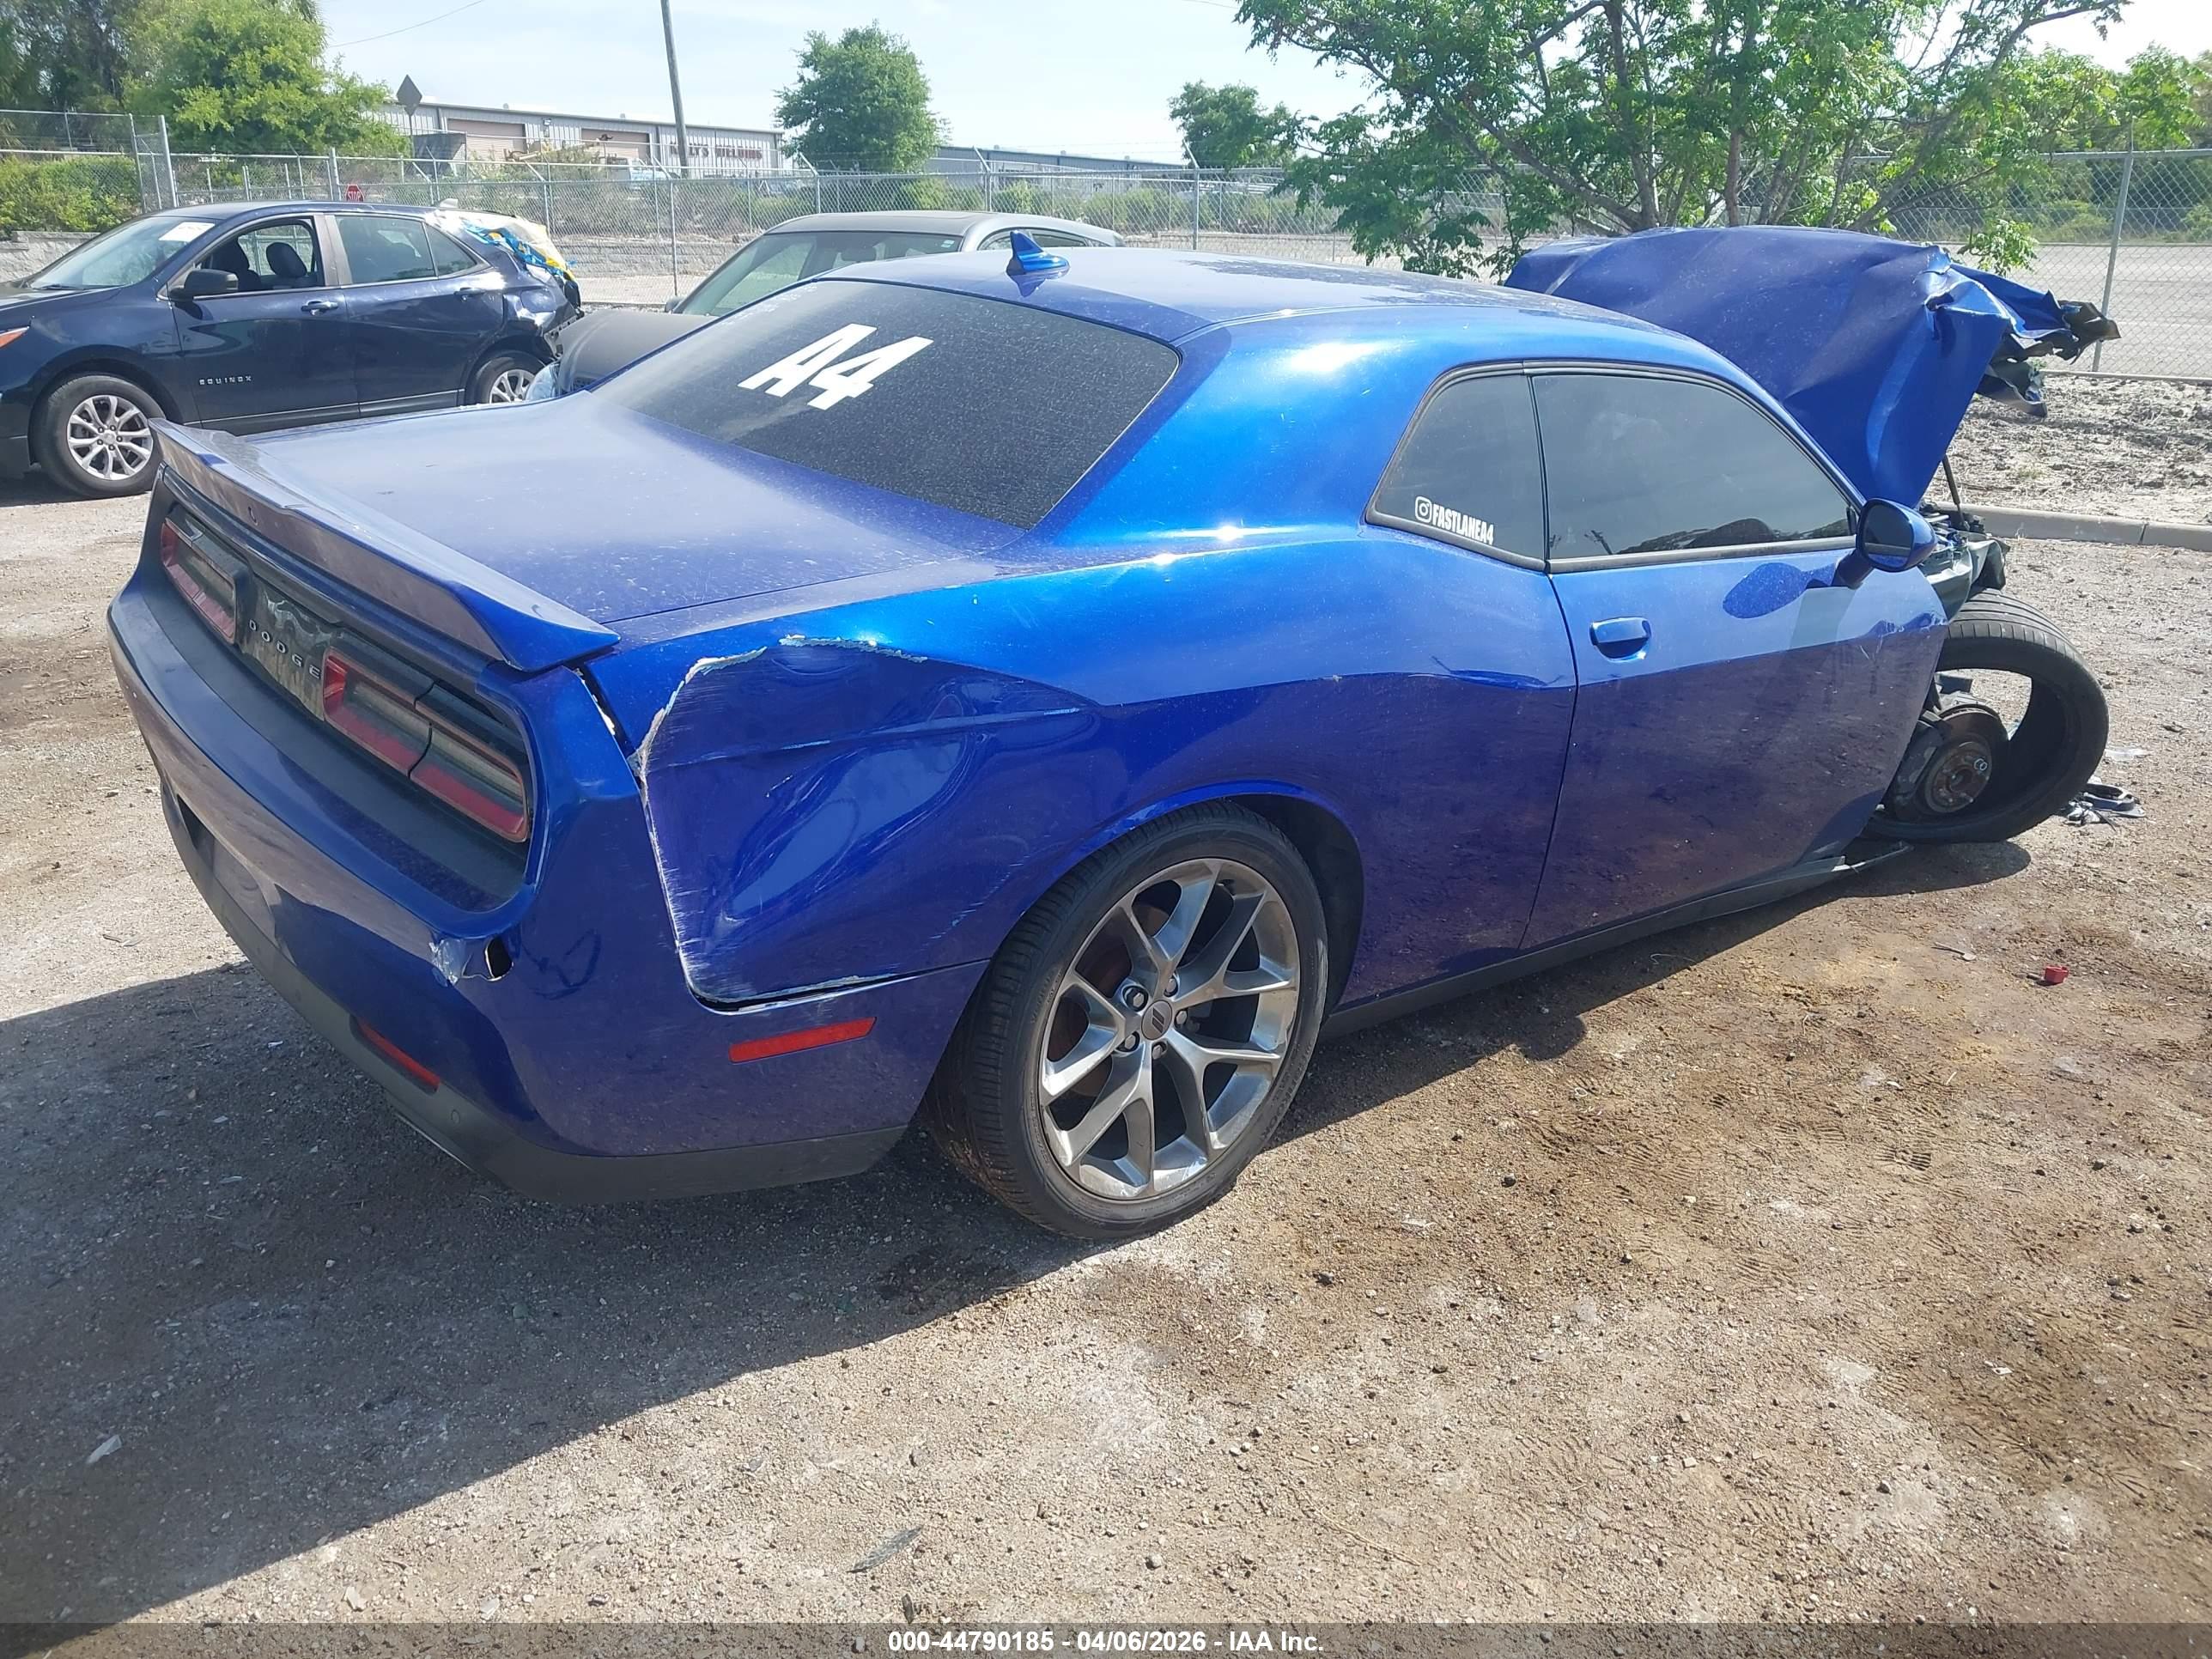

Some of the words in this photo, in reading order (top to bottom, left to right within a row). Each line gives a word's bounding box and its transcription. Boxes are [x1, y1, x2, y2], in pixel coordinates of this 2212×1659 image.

[347, 191, 362, 202] STOP
[198, 375, 252, 386] EQUINOX
[737, 323, 935, 410] A4
[1431, 503, 1495, 545] FASTLANEA4
[249, 619, 321, 679] DODGE
